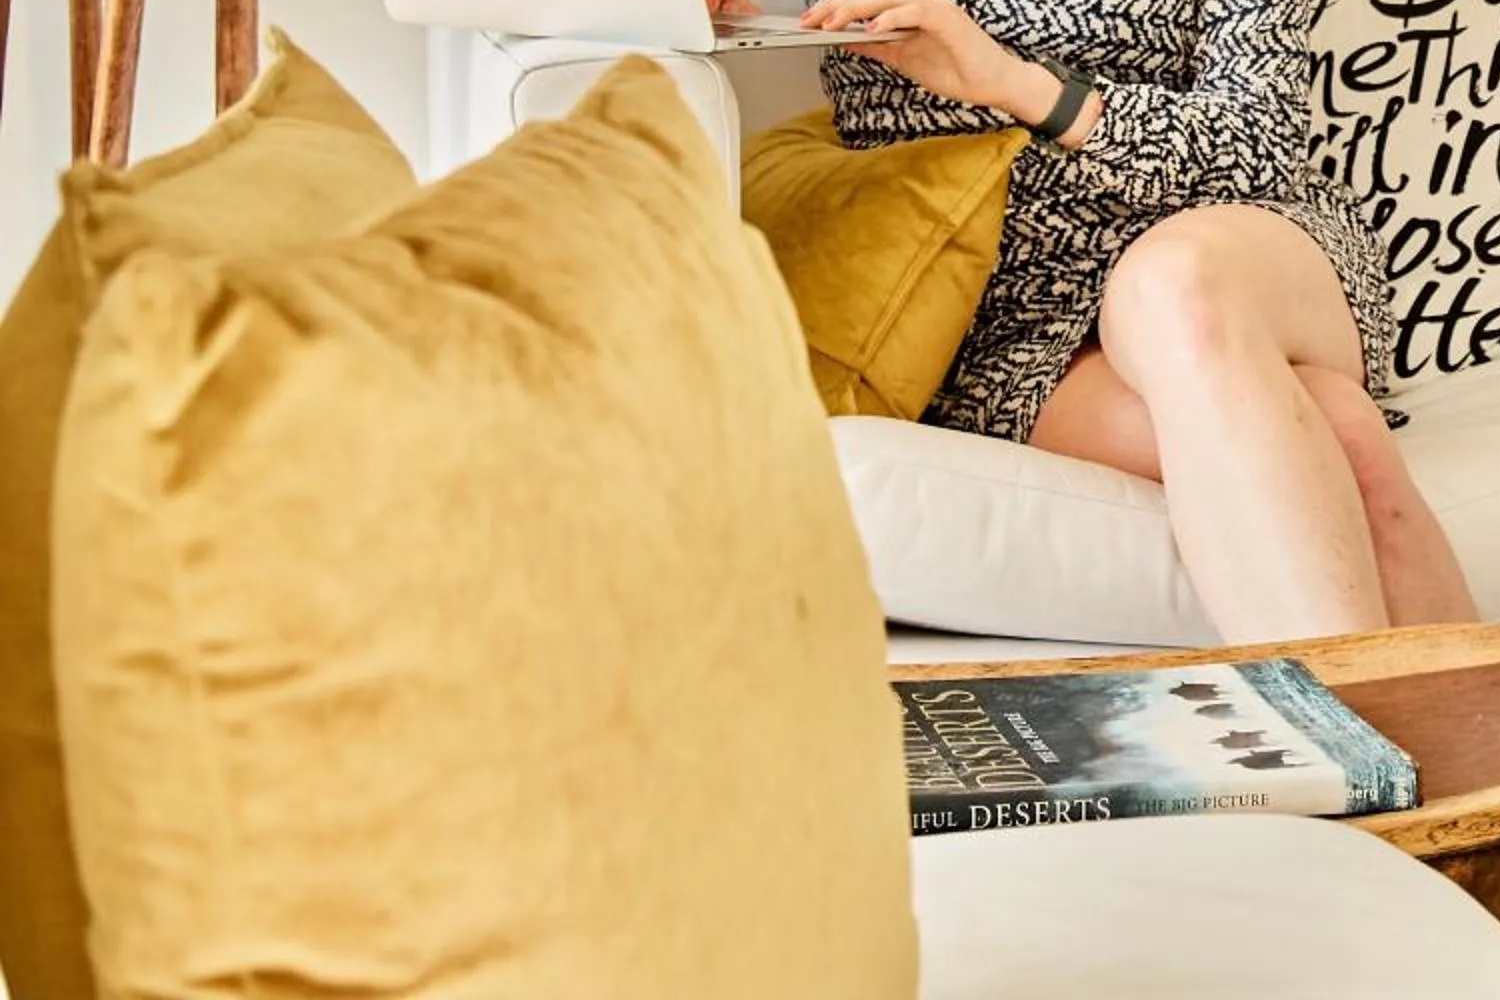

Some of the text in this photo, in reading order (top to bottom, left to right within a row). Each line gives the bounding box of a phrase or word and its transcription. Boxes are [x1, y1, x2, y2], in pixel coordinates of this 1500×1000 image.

[911, 689, 1047, 791] DESERTS
[968, 797, 1112, 831] DESERTS
[1136, 799, 1168, 814] THE
[1171, 796, 1198, 812] BIG
[1203, 792, 1269, 810] PICTURE
